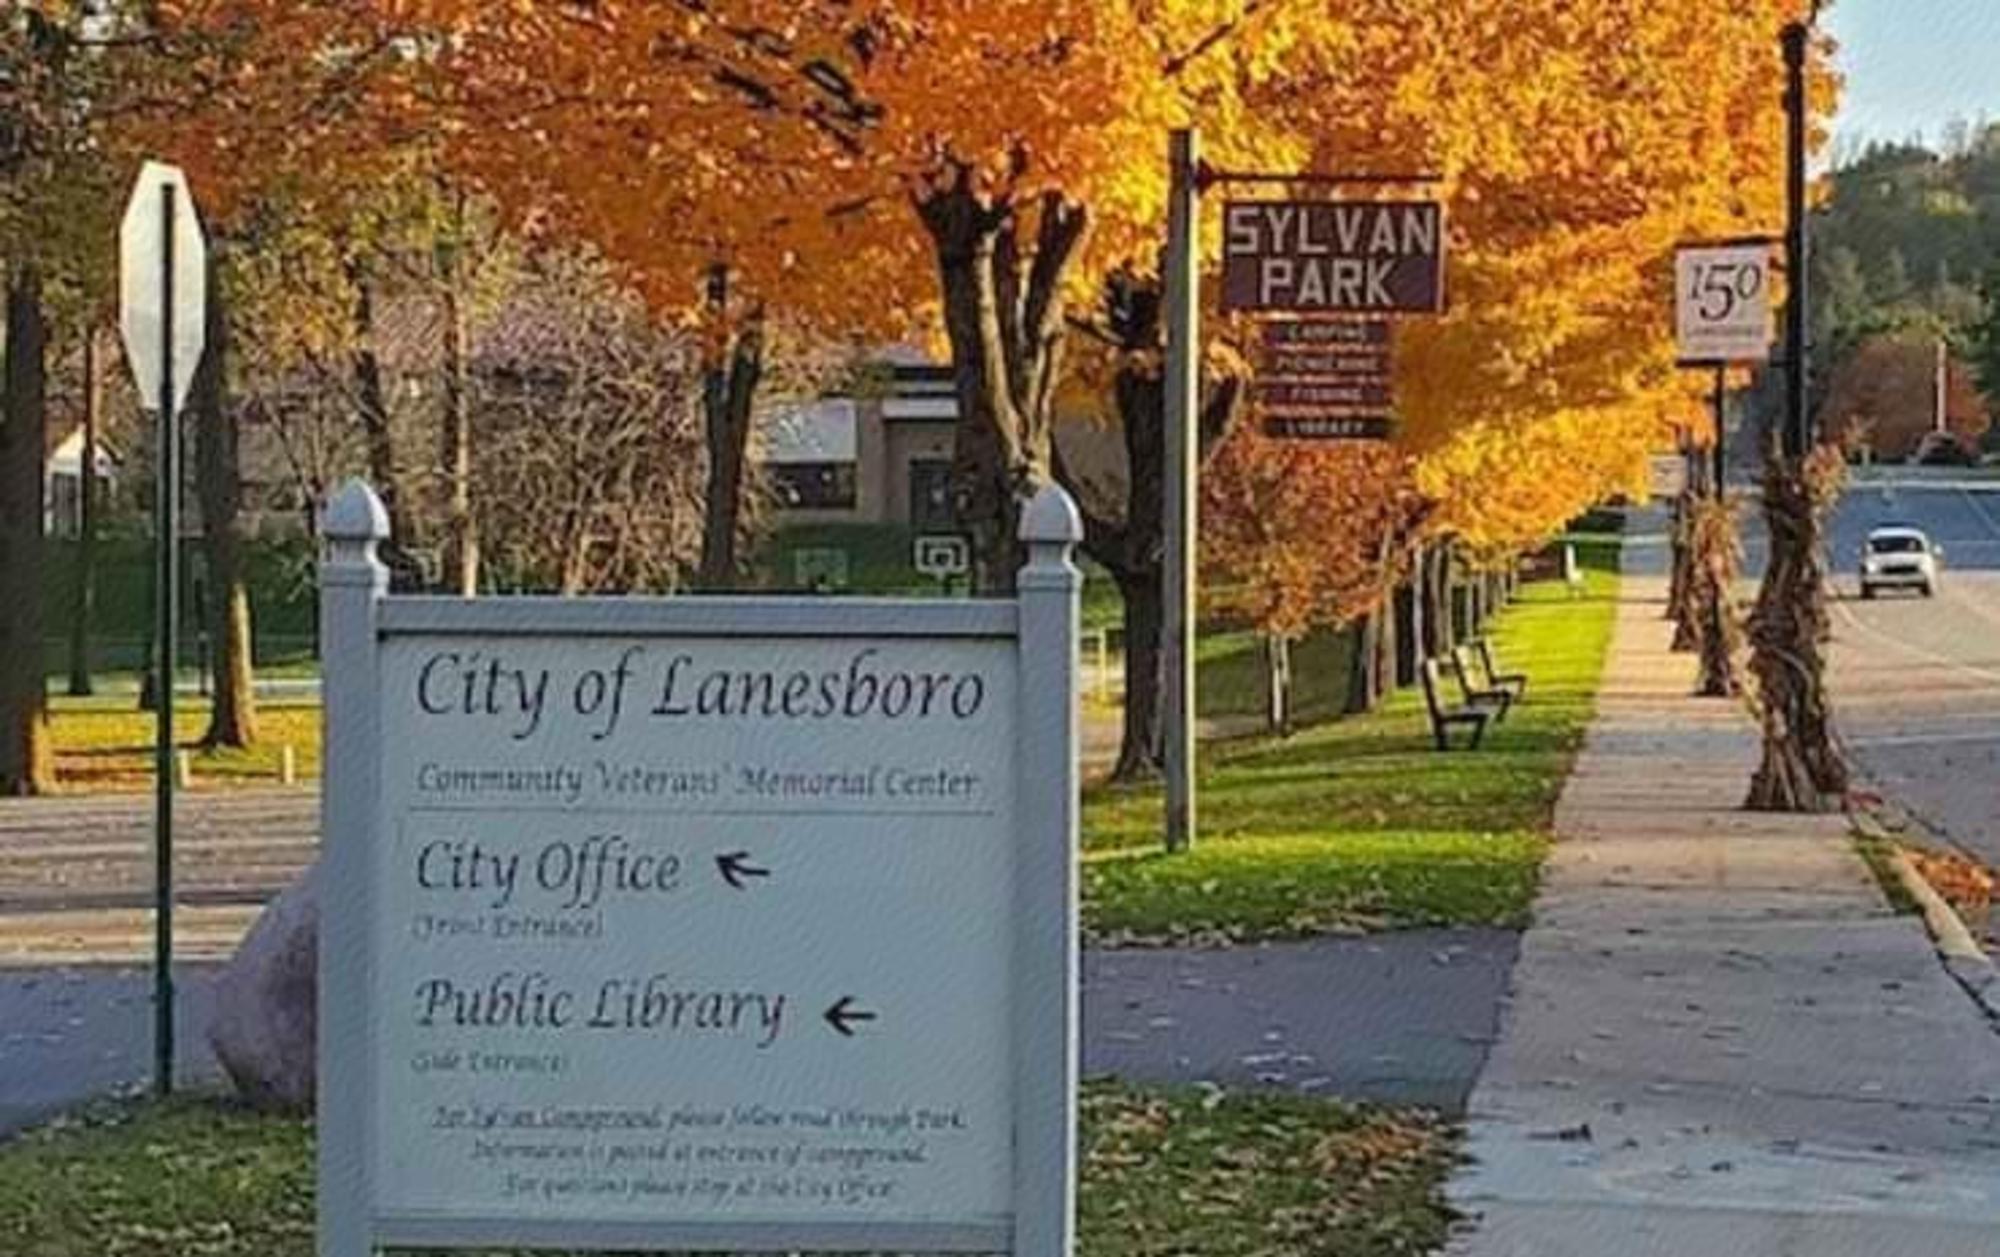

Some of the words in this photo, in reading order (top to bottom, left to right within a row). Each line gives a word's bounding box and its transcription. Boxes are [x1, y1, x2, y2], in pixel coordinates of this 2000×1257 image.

[1228, 207, 1435, 254] SYLVAN
[1260, 258, 1394, 305] PARK
[1691, 261, 1762, 321] 150
[417, 650, 549, 740] City
[573, 646, 645, 740] of
[651, 648, 985, 719] Lanesboro
[417, 763, 583, 804] Community
[735, 763, 882, 797] Memorial
[885, 766, 980, 797] Center
[417, 837, 519, 908] City
[536, 835, 682, 909] Office
[415, 971, 574, 1030] Public
[587, 972, 788, 1050] Library
